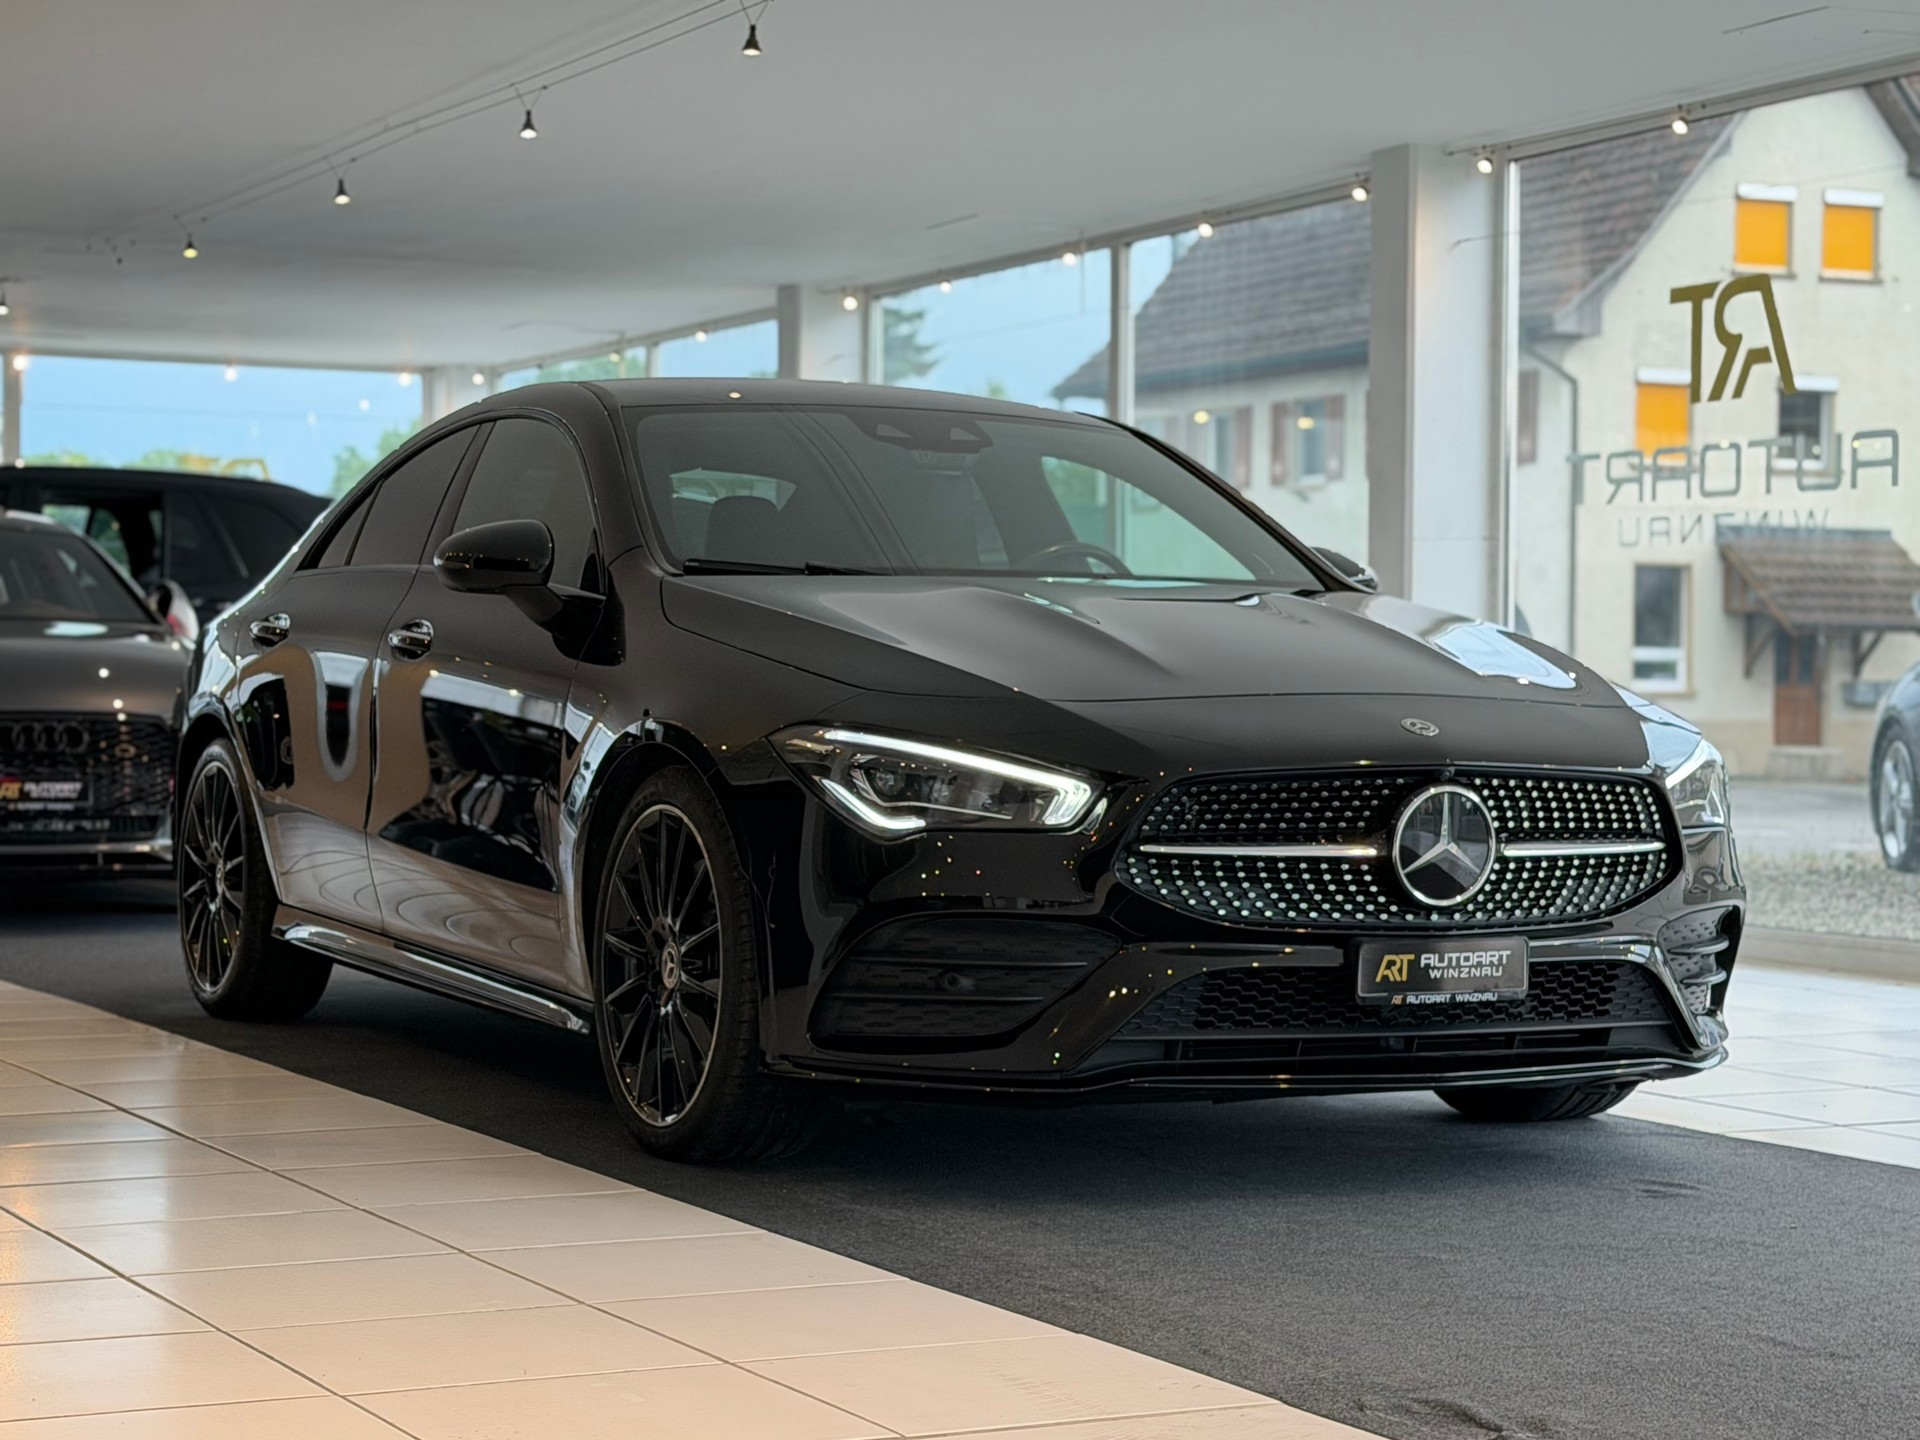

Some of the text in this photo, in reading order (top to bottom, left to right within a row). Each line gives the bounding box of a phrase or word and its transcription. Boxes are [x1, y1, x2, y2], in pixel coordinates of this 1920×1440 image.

[1420, 951, 1511, 968] AUTOART
[1376, 954, 1415, 982] ART
[1429, 967, 1502, 979] WINZNAU
[1406, 995, 1451, 1005] AUTOART
[1455, 992, 1498, 1002] WINZNAU
